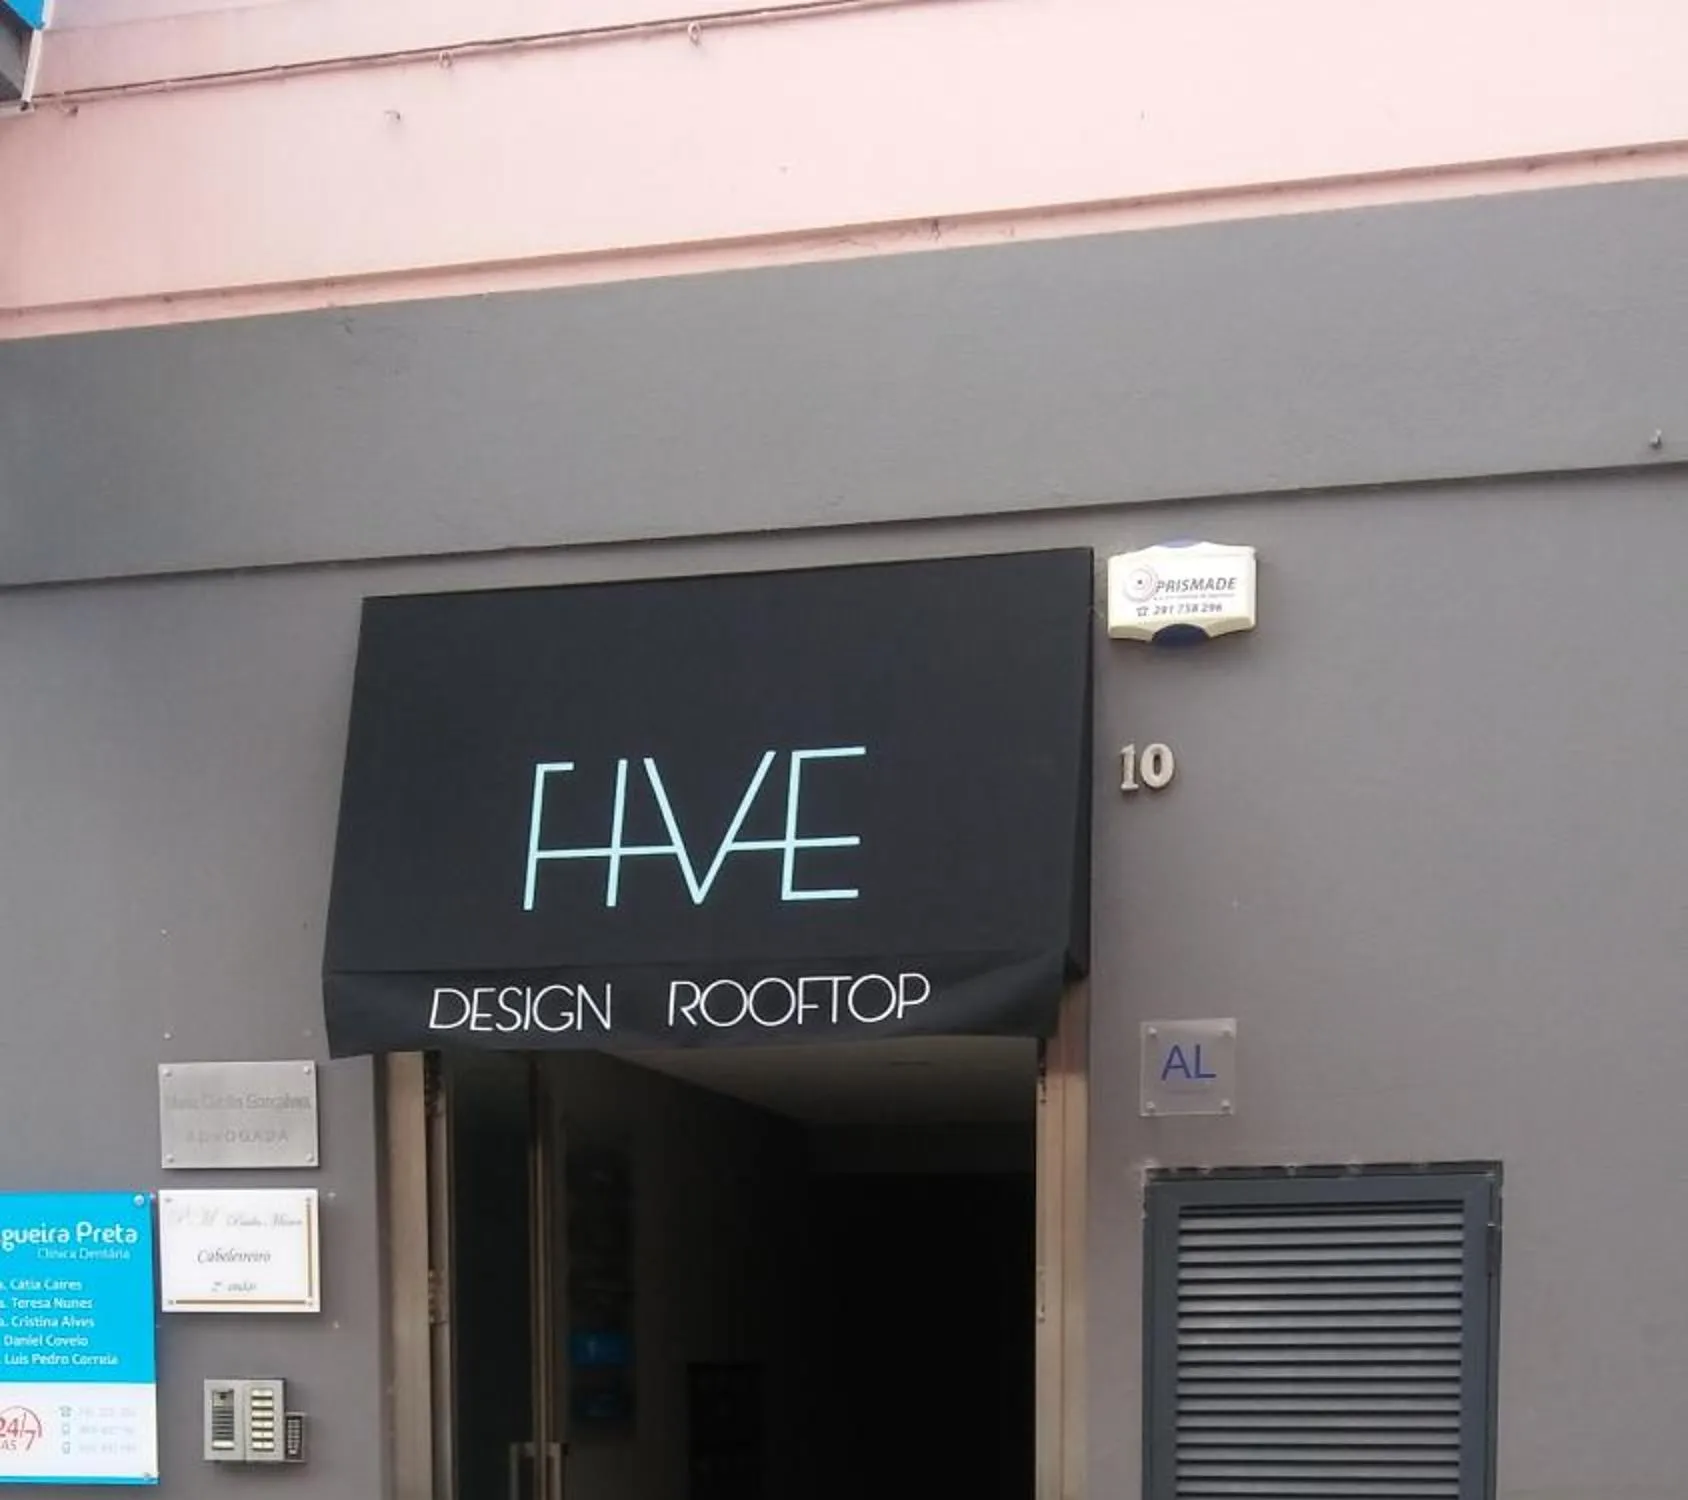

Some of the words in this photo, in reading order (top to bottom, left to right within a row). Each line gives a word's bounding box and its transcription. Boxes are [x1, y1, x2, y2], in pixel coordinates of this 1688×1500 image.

[1155, 577, 1237, 593] PRISMADE
[1119, 742, 1175, 790] 10
[522, 745, 866, 910] FIVE
[428, 982, 612, 1032] DESIGN
[667, 972, 931, 1028] ROOFTOP
[1161, 1043, 1217, 1081] AL
[0, 1222, 71, 1252] gueira
[76, 1221, 139, 1244] Preta
[11, 1297, 52, 1309] Teresa
[54, 1297, 94, 1309] Nunes
[11, 1315, 59, 1328] Cristina
[61, 1315, 95, 1328] Alves
[3, 1334, 43, 1347] Daniel
[31, 1352, 70, 1365] Pedro
[71, 1352, 120, 1365] Correia
